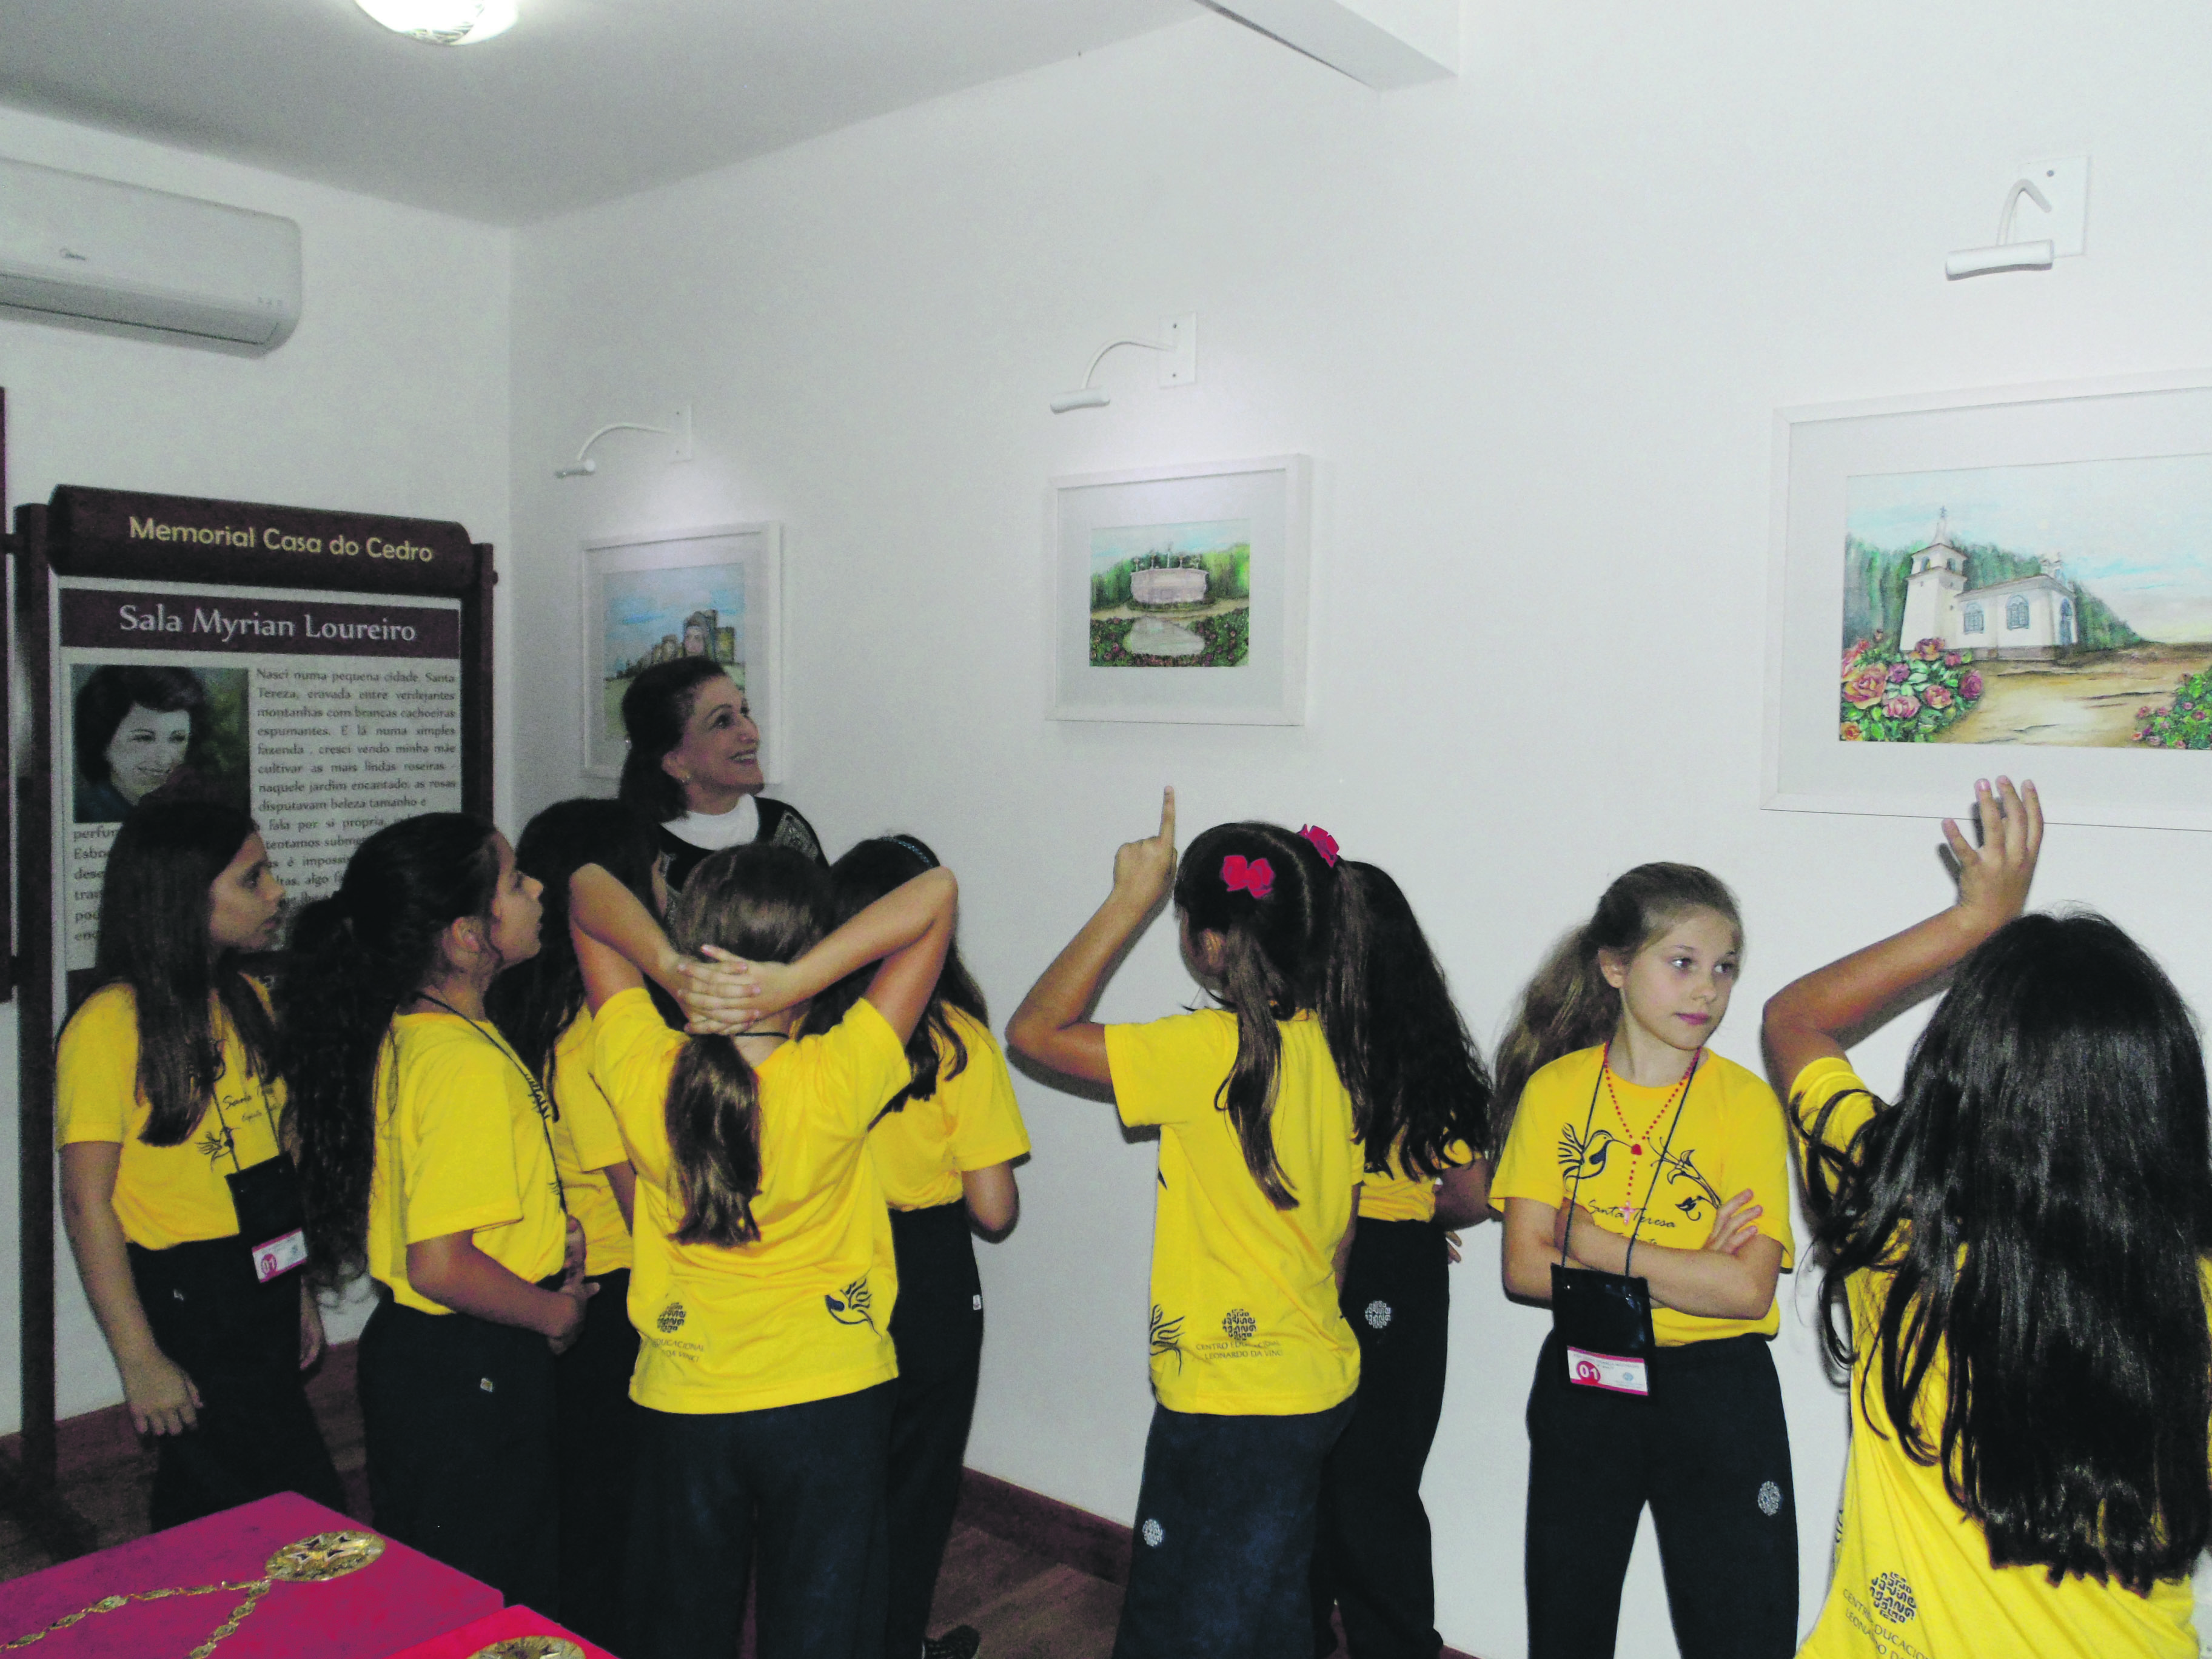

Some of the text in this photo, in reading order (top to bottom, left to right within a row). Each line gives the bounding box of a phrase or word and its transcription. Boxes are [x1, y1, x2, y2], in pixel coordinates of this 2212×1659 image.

[130, 516, 432, 563] Memorial Casa do Cedro
[119, 603, 416, 642] Sala Myrian Loureiro
[256, 668, 288, 680] Nasci
[294, 672, 327, 681] numa
[332, 672, 380, 683] pequena
[426, 672, 455, 683] Santa
[359, 691, 388, 700] entre
[257, 706, 455, 718] montanhas com brancas cachoeiras
[416, 725, 455, 738] simples
[319, 744, 351, 754] cresci
[357, 742, 389, 753] vendo
[395, 742, 429, 752] minha
[434, 743, 456, 752] mãe
[258, 762, 303, 774] cultivar
[310, 765, 323, 773] as
[331, 763, 358, 773] mais
[364, 761, 397, 772] lindas
[258, 782, 304, 795] naquele
[309, 779, 347, 793] jardim
[258, 799, 327, 814] disputavam
[330, 797, 366, 810] beleza
[369, 796, 418, 807] tamanho
[269, 819, 290, 830] fala
[298, 822, 319, 833] por
[1587, 1199, 1625, 1218] Santa
[1196, 1342, 1228, 1350] CENTRO
[1204, 1350, 1248, 1360] LEONARDO
[1579, 1364, 1598, 1381] 01
